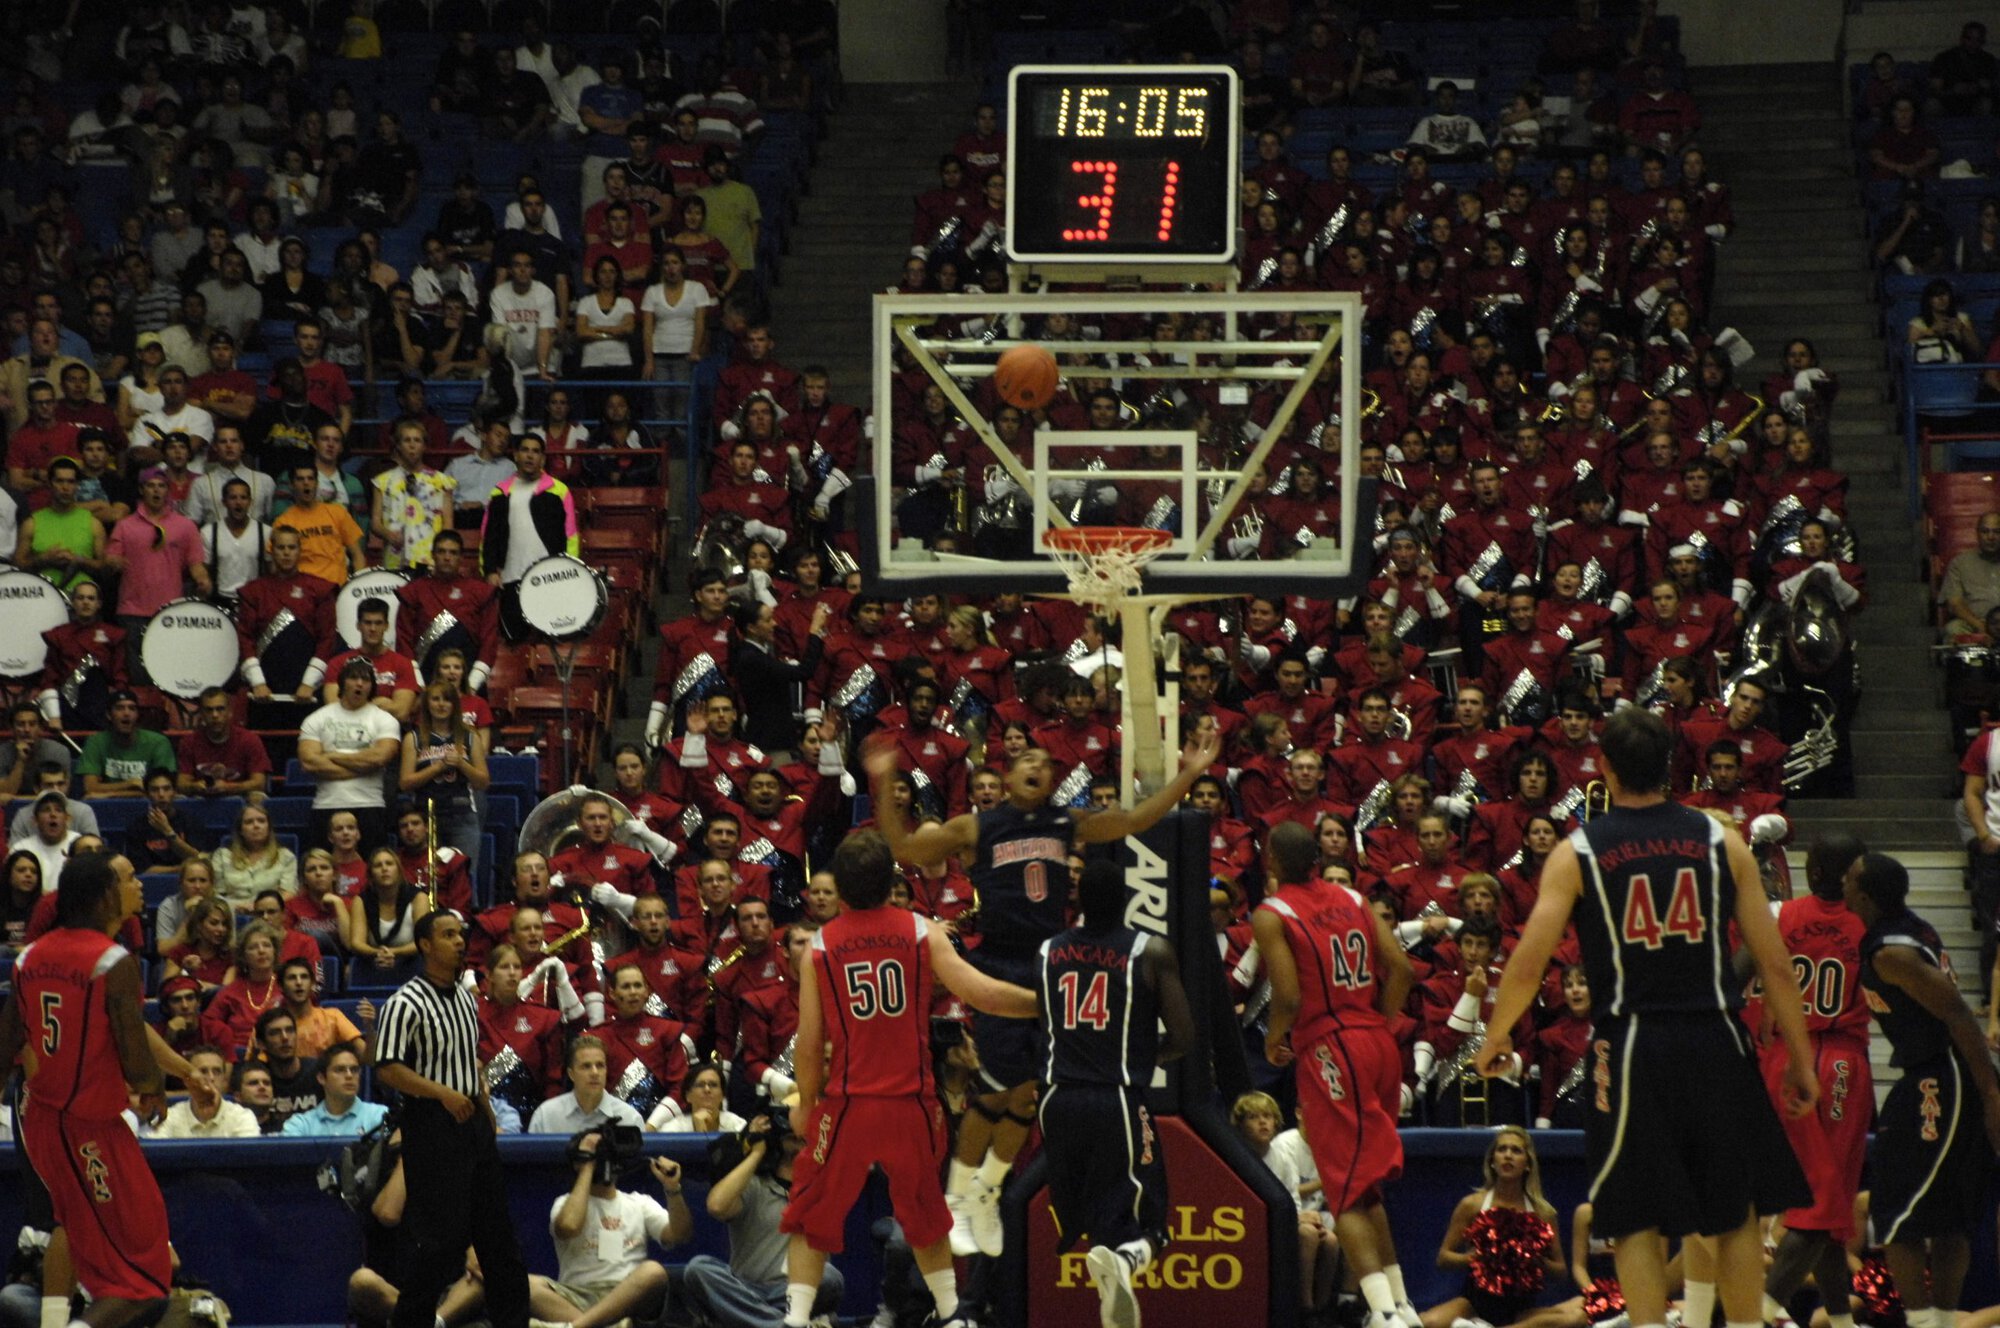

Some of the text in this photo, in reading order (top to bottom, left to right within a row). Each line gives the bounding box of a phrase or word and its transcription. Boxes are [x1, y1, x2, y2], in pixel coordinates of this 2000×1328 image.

[1057, 87, 1208, 137] 16:05
[1062, 160, 1181, 242] 31
[363, 584, 400, 598] YAMAH
[541, 568, 580, 584] YAMAHA
[175, 615, 223, 630] YAMAHA
[1023, 861, 1049, 903] 0
[1622, 867, 1706, 951] 44
[843, 957, 907, 1020] 50
[1329, 928, 1372, 991] 42
[1791, 953, 1846, 1018] 20
[40, 991, 62, 1057] 5
[1058, 970, 1110, 1031] 14
[1830, 1060, 1849, 1120] CATS
[1919, 1077, 1941, 1141] CATS
[1055, 1252, 1244, 1290] FRGO
